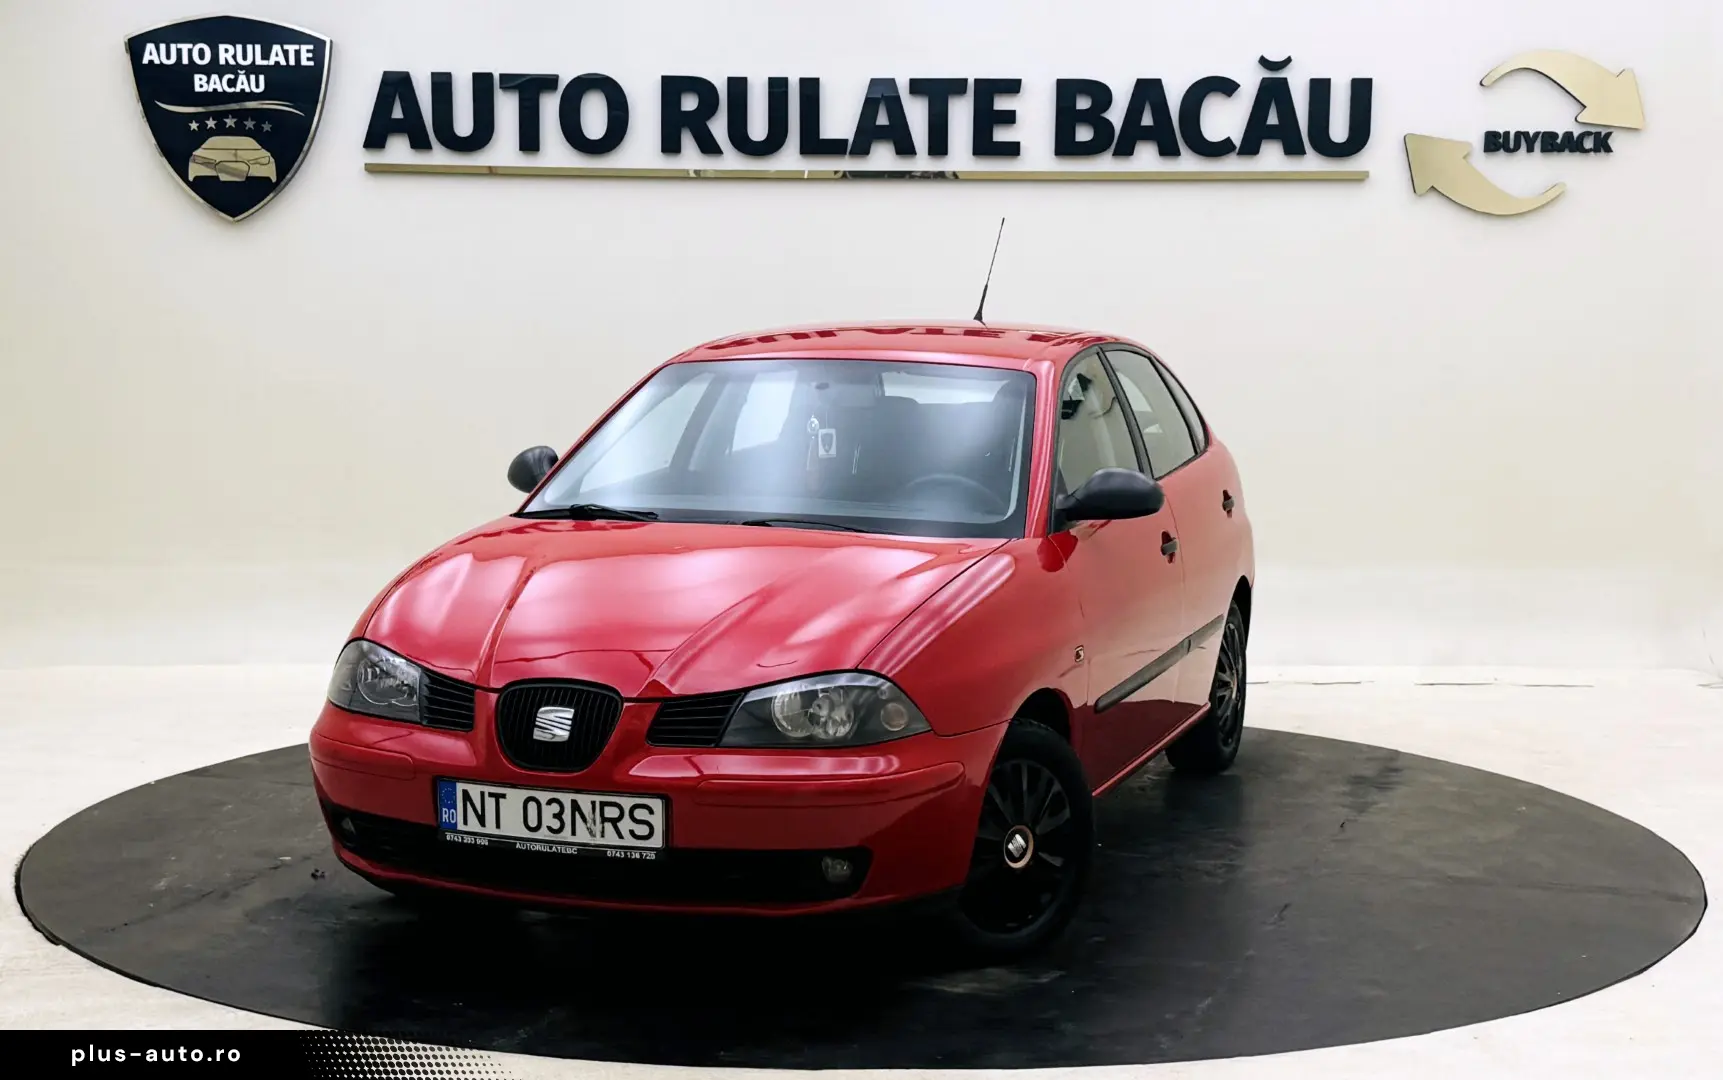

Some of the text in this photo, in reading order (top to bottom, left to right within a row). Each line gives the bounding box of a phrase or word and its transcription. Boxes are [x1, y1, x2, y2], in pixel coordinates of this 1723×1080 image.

[142, 43, 315, 66] AUTO RULATE
[194, 70, 265, 93] BACĂU
[362, 55, 1373, 159] AUTO RULATE BACĂU
[1483, 130, 1614, 154] BUYBACK
[442, 807, 456, 824] RO
[461, 788, 507, 830] NT
[606, 850, 625, 859] 0743
